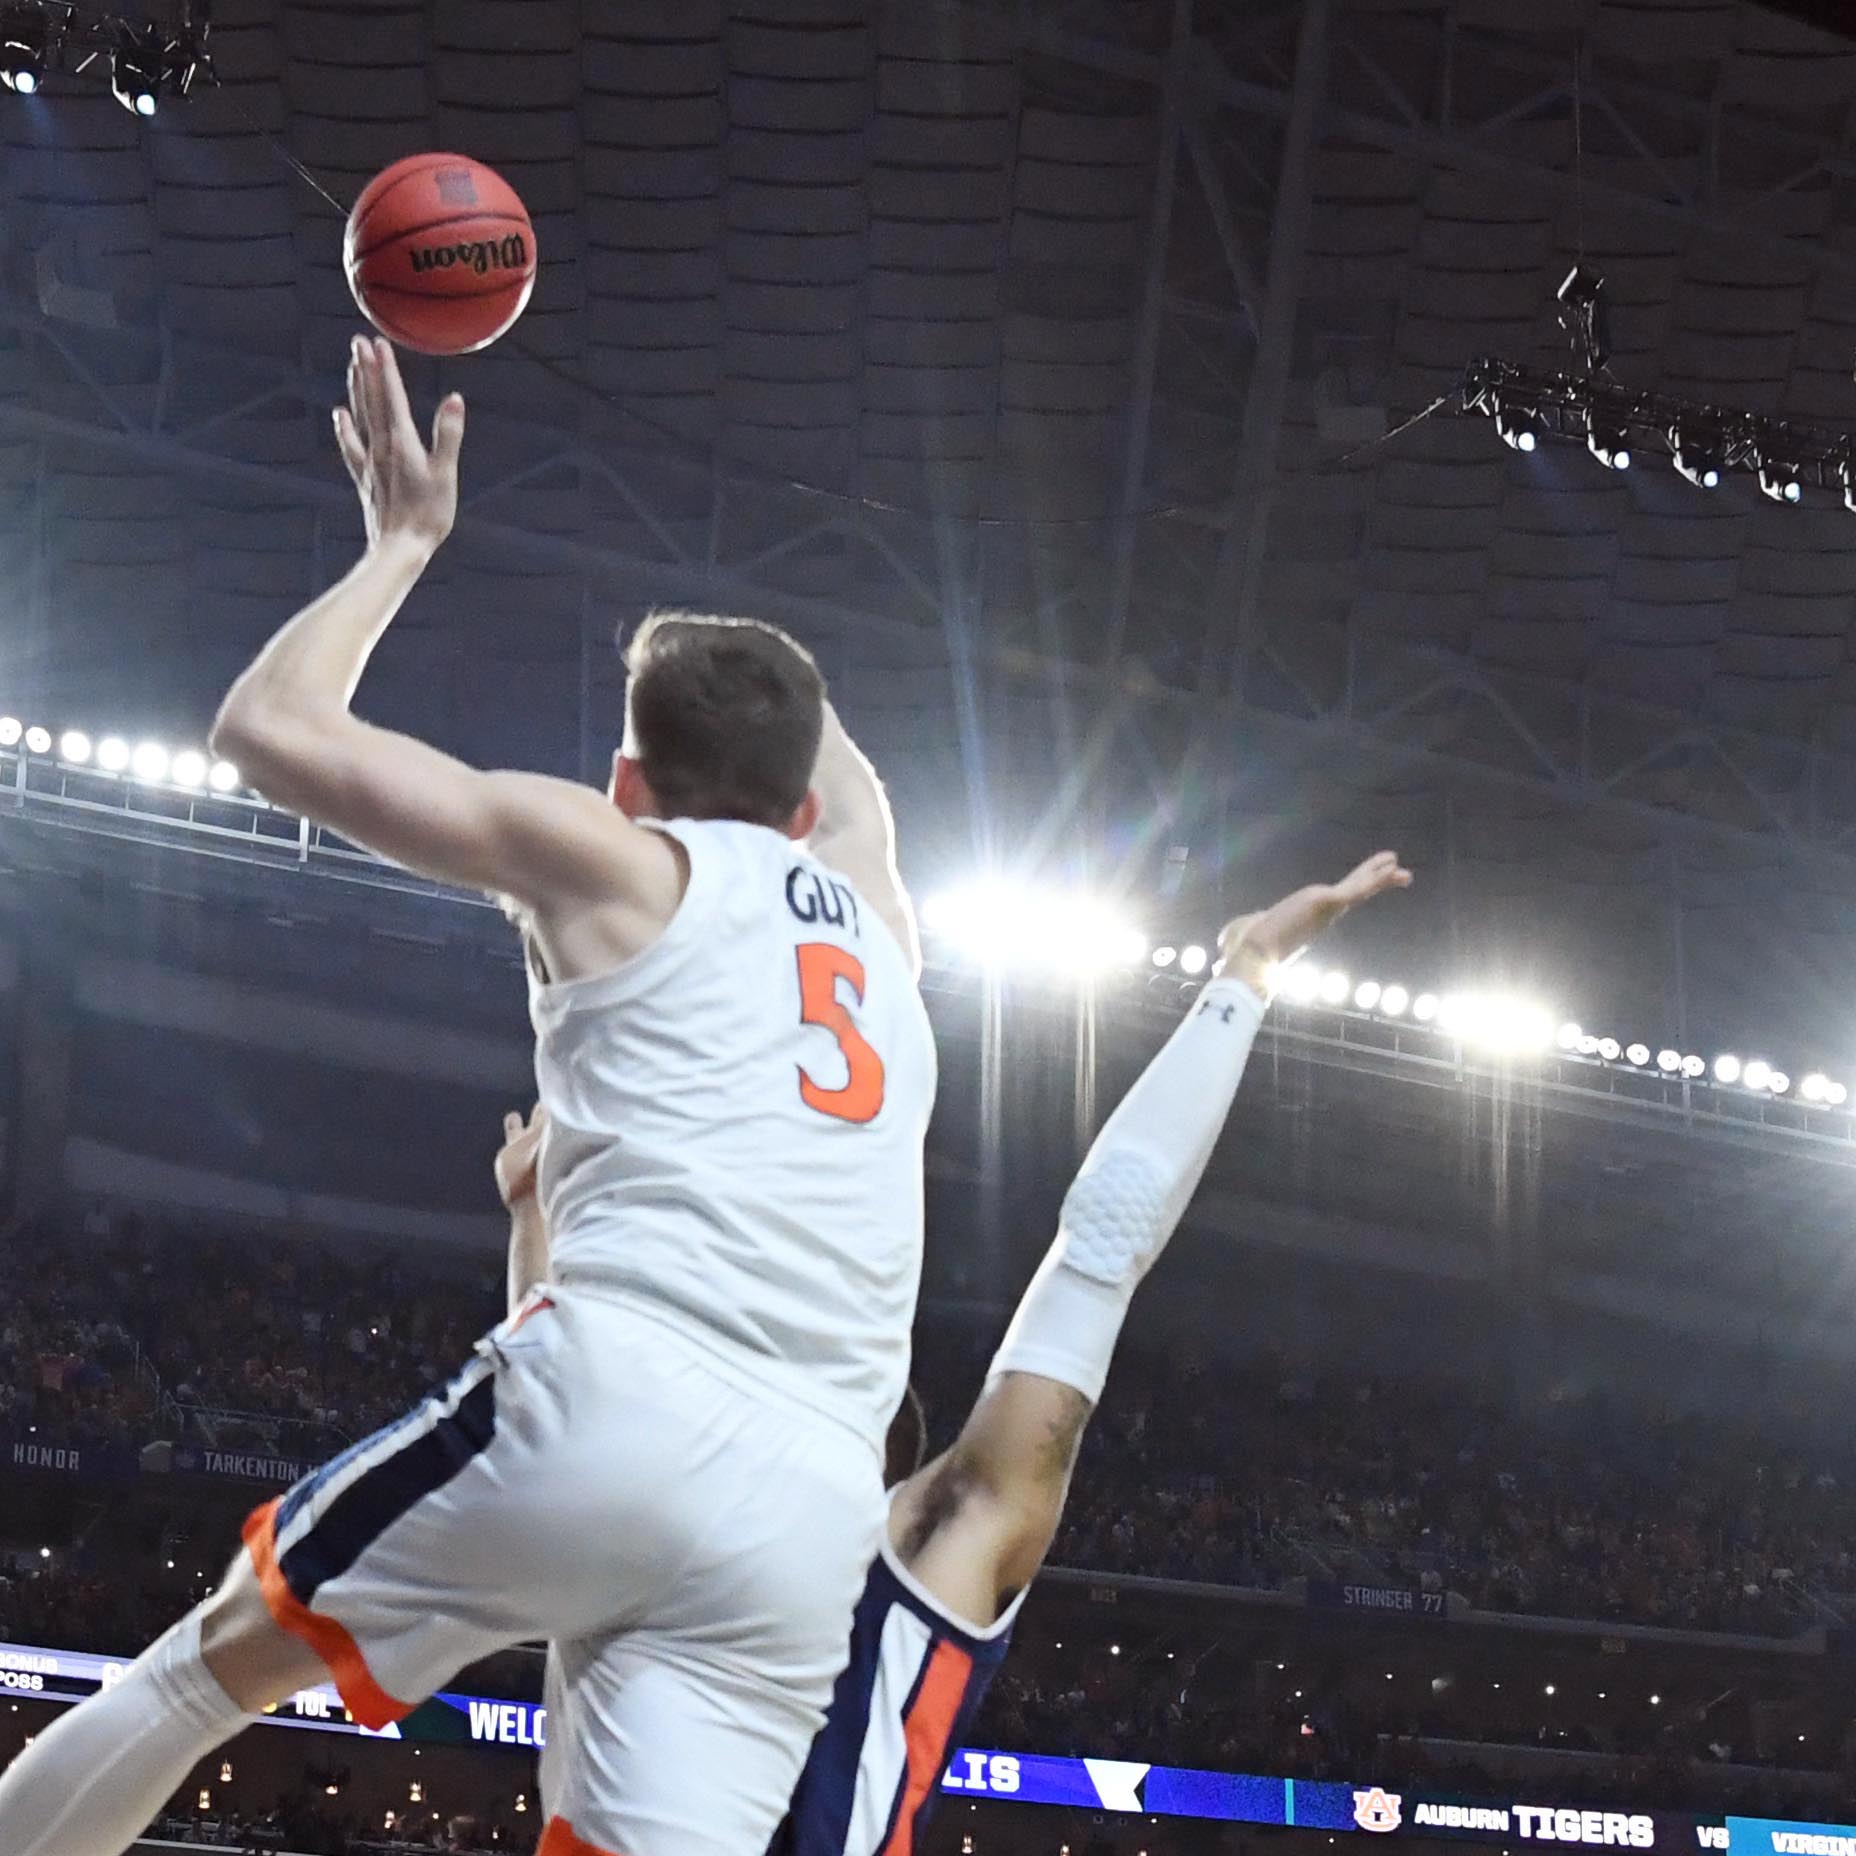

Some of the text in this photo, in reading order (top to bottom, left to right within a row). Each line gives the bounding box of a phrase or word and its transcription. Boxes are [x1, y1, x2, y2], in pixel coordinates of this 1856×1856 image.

[794, 942, 885, 1125] 5
[13, 1443, 80, 1472] HONOR
[204, 1450, 300, 1482] TARKENTON
[1343, 1585, 1414, 1611] STRINGER
[1415, 1803, 1509, 1831] AUBURN
[1512, 1805, 1654, 1848] TIGERS
[1696, 1825, 1731, 1849] VS
